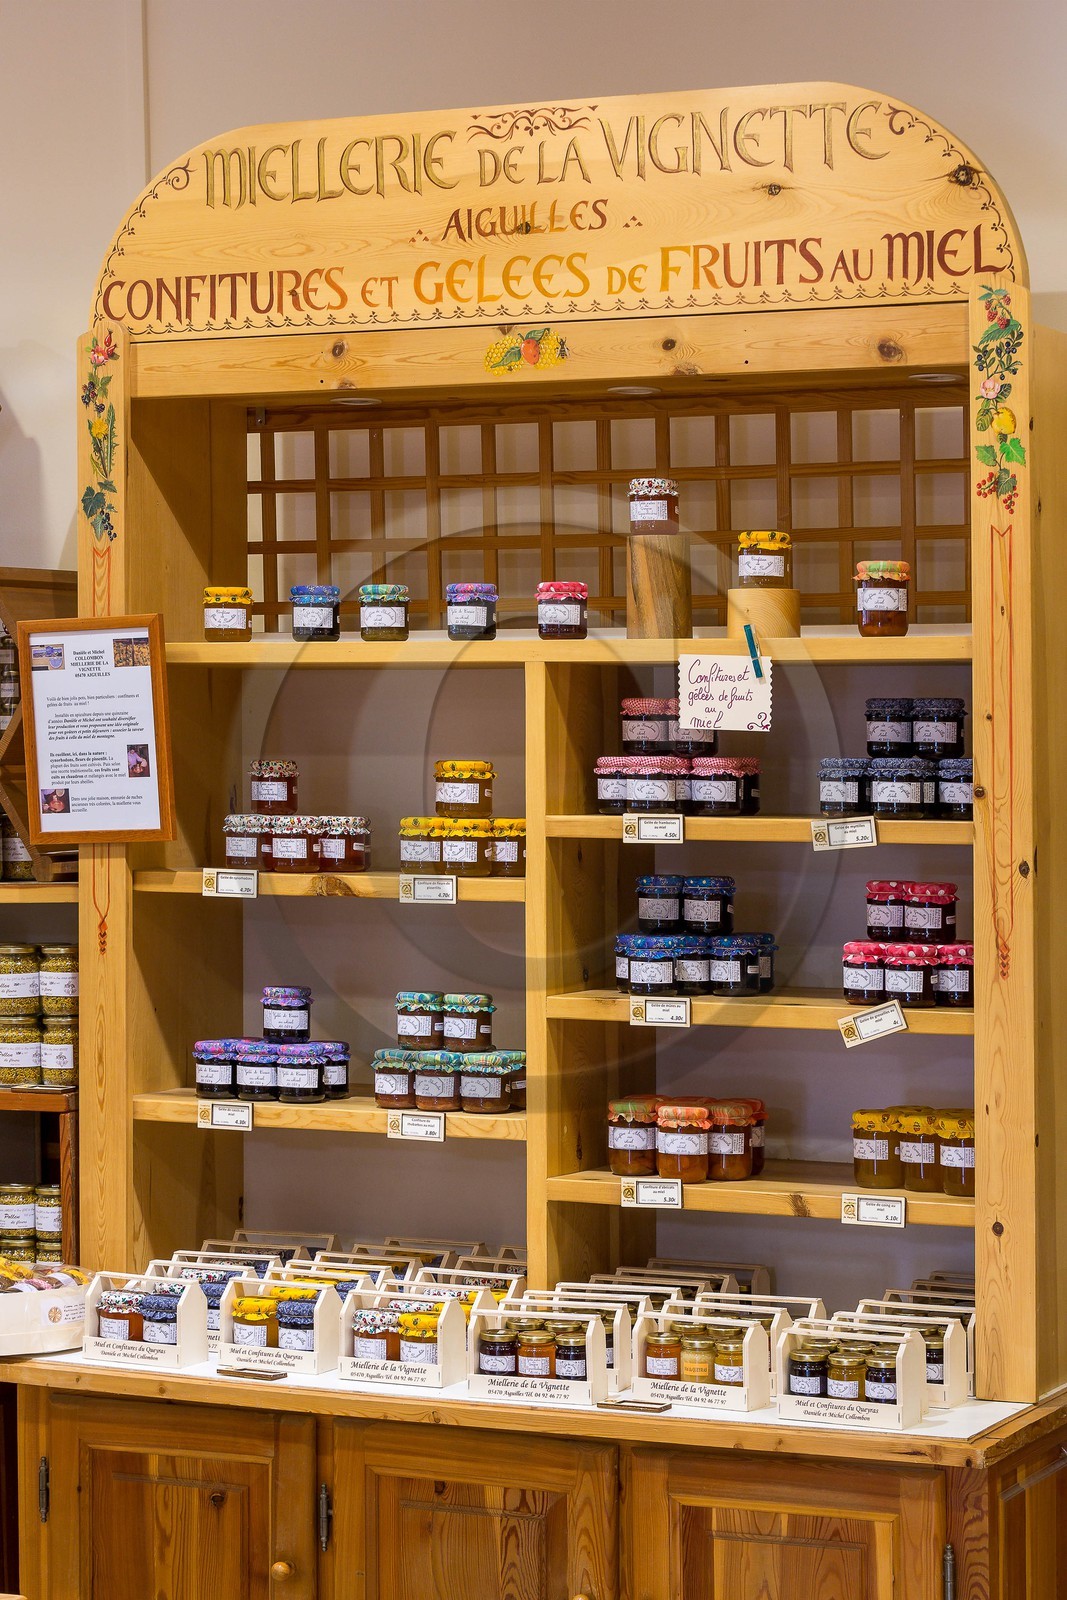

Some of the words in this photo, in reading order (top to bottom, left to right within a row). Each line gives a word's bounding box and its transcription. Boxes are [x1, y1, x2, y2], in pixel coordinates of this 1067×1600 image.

[200, 130, 462, 210] MIELLERIE
[476, 145, 525, 187] DE
[537, 136, 591, 185] LA
[598, 100, 892, 182] VIGNETTE
[441, 199, 608, 241] AIGUILLES
[102, 266, 348, 325] CONFITURES
[360, 276, 399, 310] ET
[413, 252, 590, 305] GELEES
[606, 263, 648, 295] DE
[660, 237, 823, 292] FRUITS
[829, 248, 874, 285] AU
[880, 223, 1010, 286] MIEL
[688, 659, 736, 693] Confitures
[737, 665, 750, 682] et
[718, 690, 728, 702] de
[728, 686, 753, 709] fruits
[690, 710, 724, 728] miel
[112, 1342, 137, 1351] Confitures
[146, 1346, 165, 1355] Queyras
[248, 1349, 274, 1357] Confitures
[283, 1353, 303, 1361] Queyras
[350, 1361, 379, 1370] Miellerie
[381, 1362, 388, 1371] de
[397, 1364, 426, 1374] Vignette
[488, 1379, 519, 1387] Miellerie
[520, 1380, 528, 1388] de
[531, 1380, 537, 1388] la
[539, 1382, 570, 1392] Vignette
[651, 1382, 679, 1391] Miellerie
[698, 1386, 726, 1397] Vignette
[816, 1402, 845, 1410] Confitures
[856, 1406, 878, 1414] Queyras
